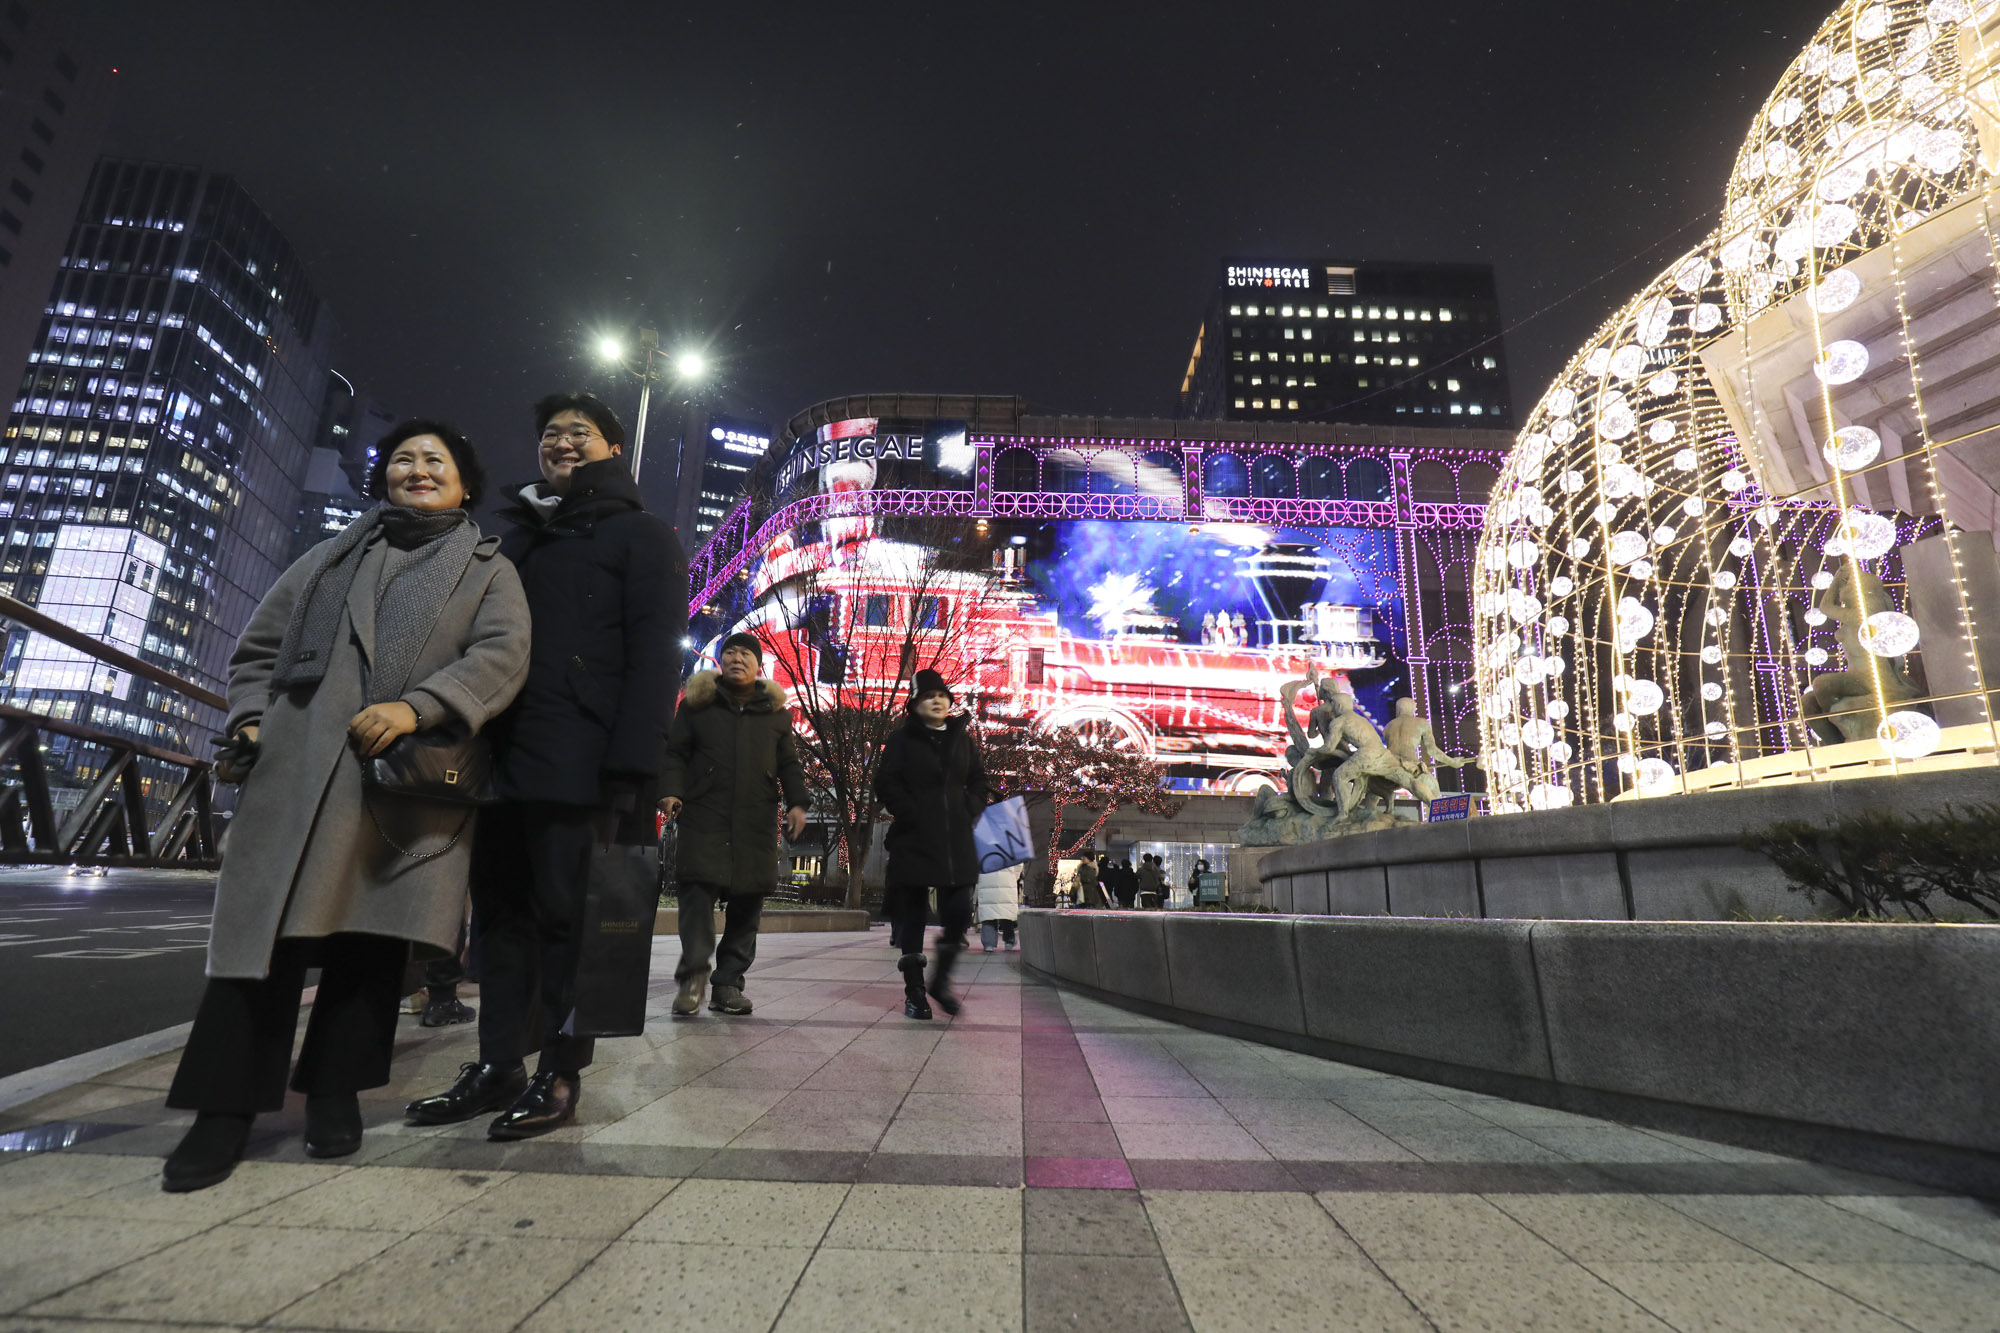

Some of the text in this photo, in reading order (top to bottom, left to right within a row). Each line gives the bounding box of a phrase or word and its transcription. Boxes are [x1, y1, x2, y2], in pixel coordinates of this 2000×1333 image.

[1228, 266, 1310, 279] SHINSEGAE
[1228, 277, 1310, 288] DUTY FREE
[1648, 347, 1678, 365] CAPE
[725, 431, 770, 449] 우리은행
[775, 434, 923, 495] SHINSEGAE
[1432, 796, 1468, 814] 감전위험
[600, 920, 640, 928] SHINSEGAE
